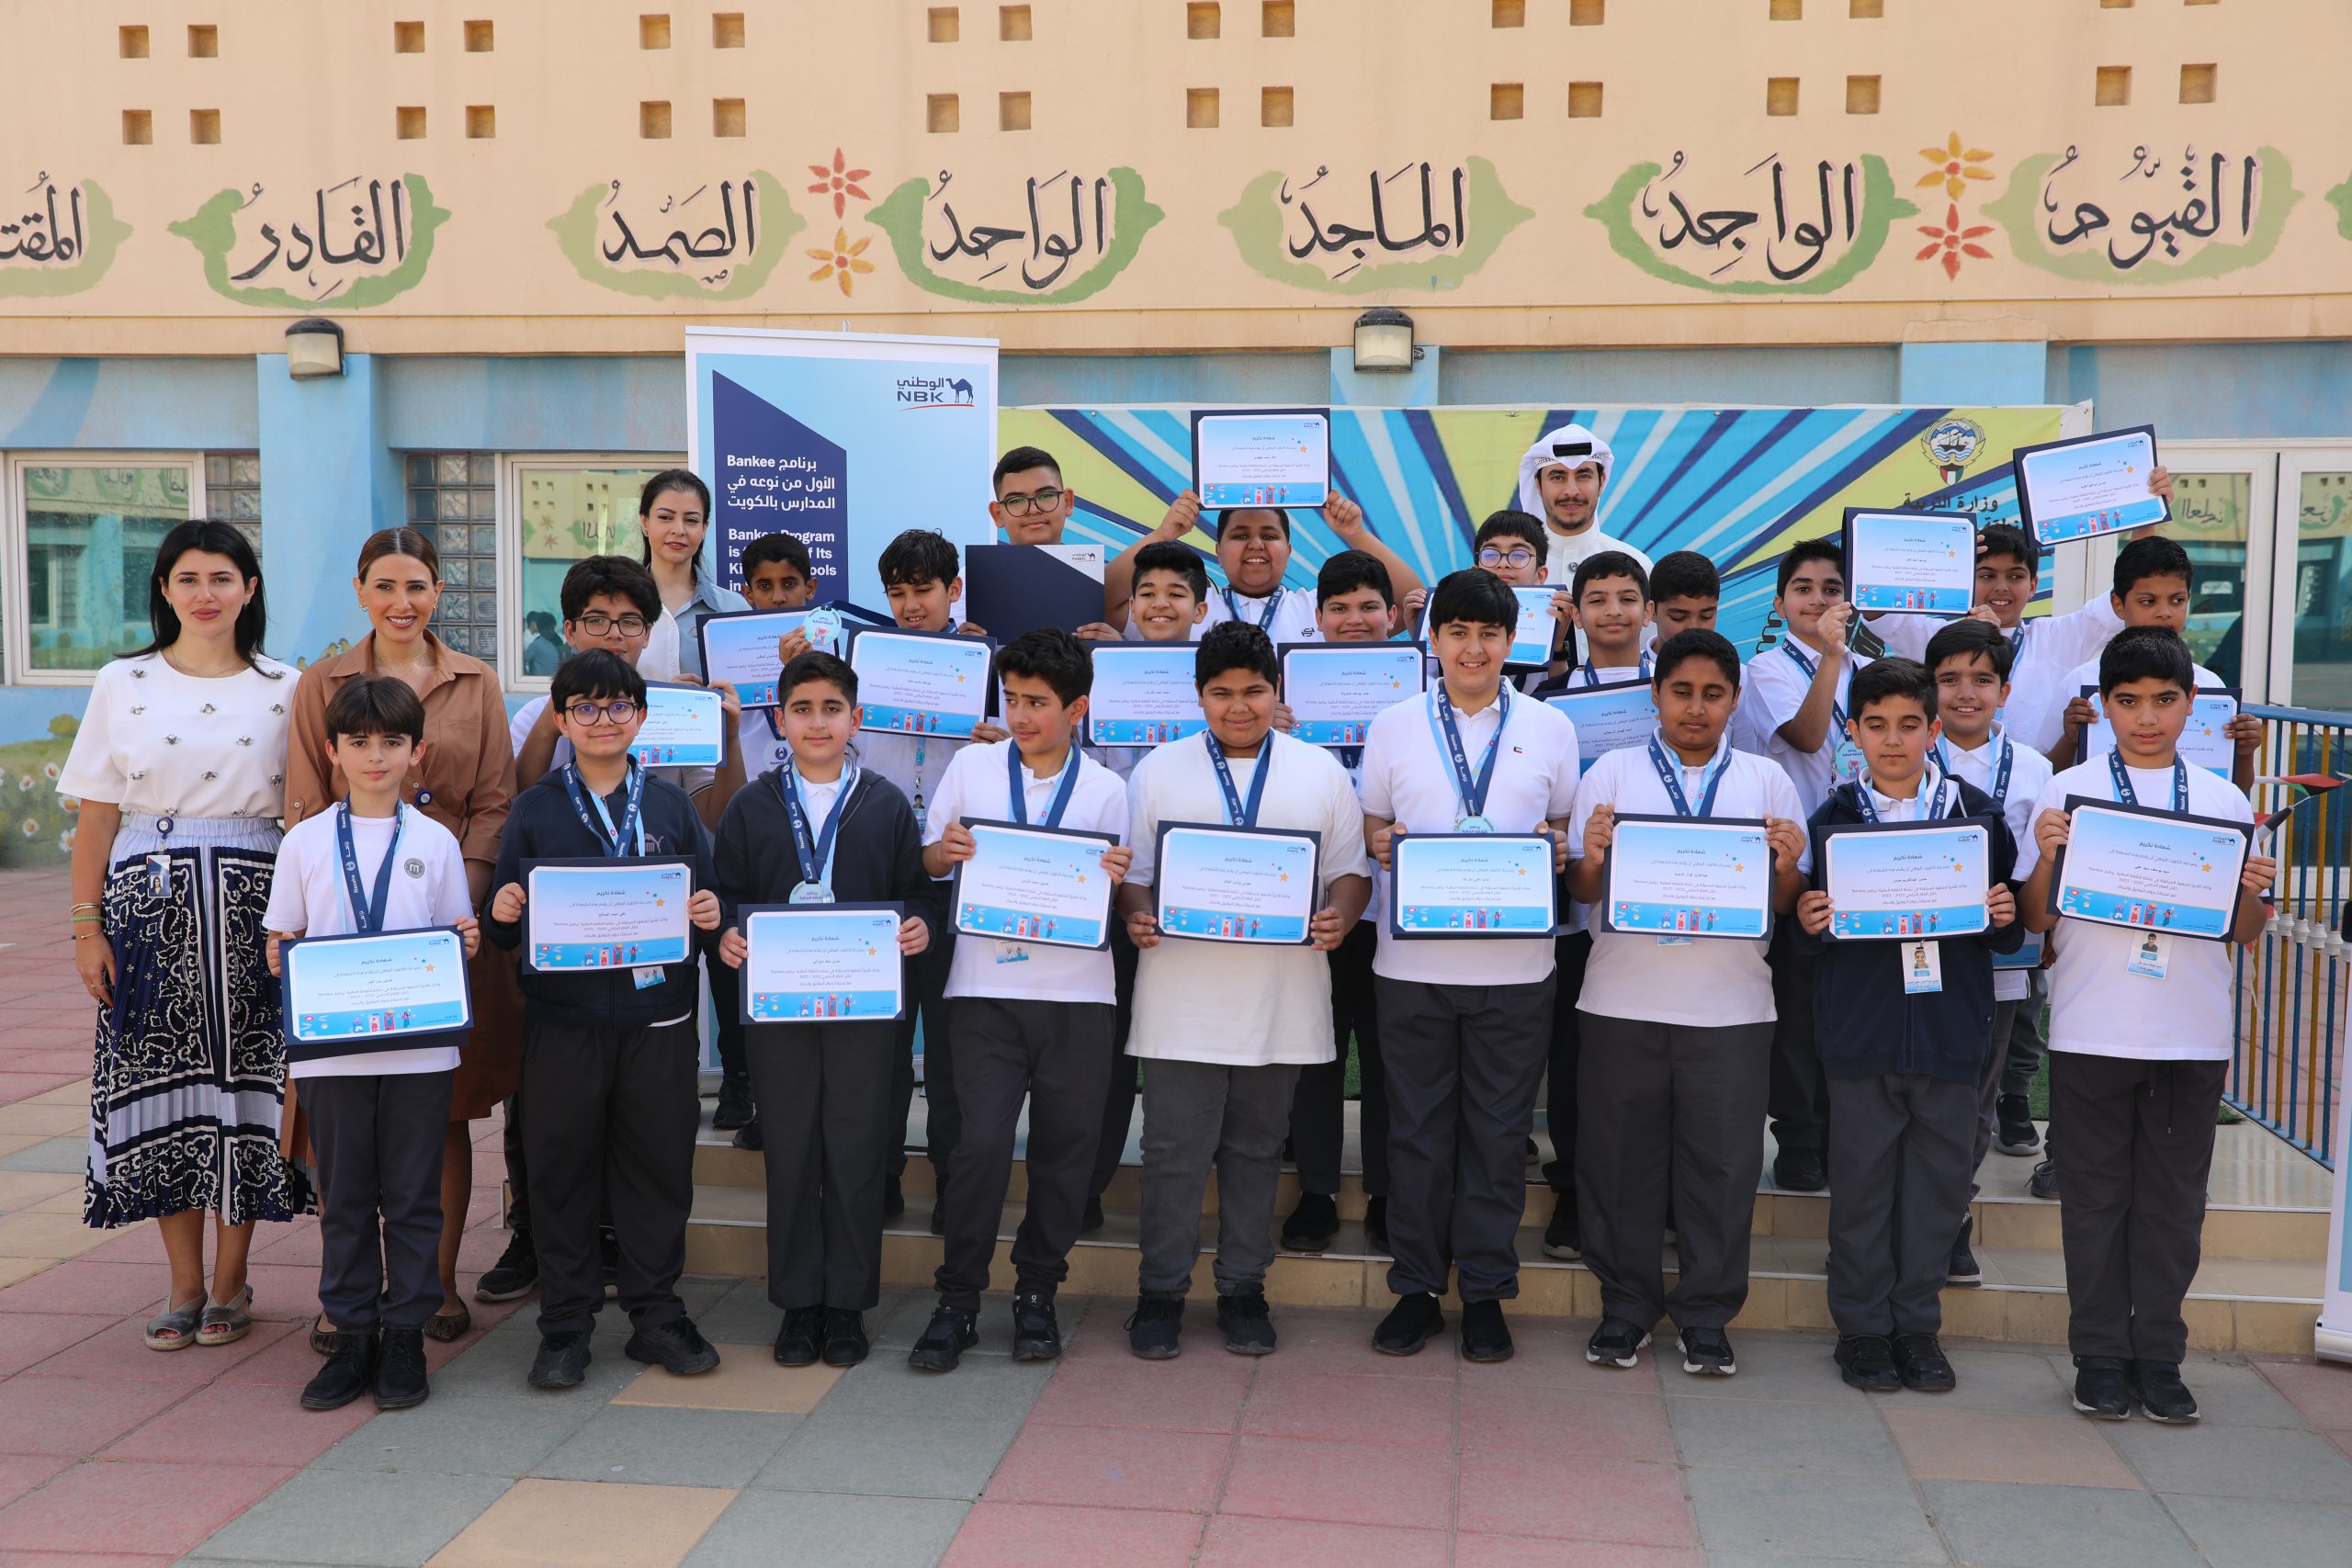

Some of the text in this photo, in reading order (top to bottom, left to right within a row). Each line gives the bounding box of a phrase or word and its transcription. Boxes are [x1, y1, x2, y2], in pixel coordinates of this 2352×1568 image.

[0, 171, 82, 261] المقت
[897, 377, 944, 390] الوطني
[897, 390, 944, 402] NBK
[728, 455, 816, 472] برنامج Bankee
[728, 475, 834, 493] الأول من نوعه في
[728, 495, 835, 511] المدارس بالكويت
[729, 528, 775, 540] Bank
[729, 546, 740, 557] is
[816, 547, 832, 558] Its
[729, 563, 837, 576] Ki ools
